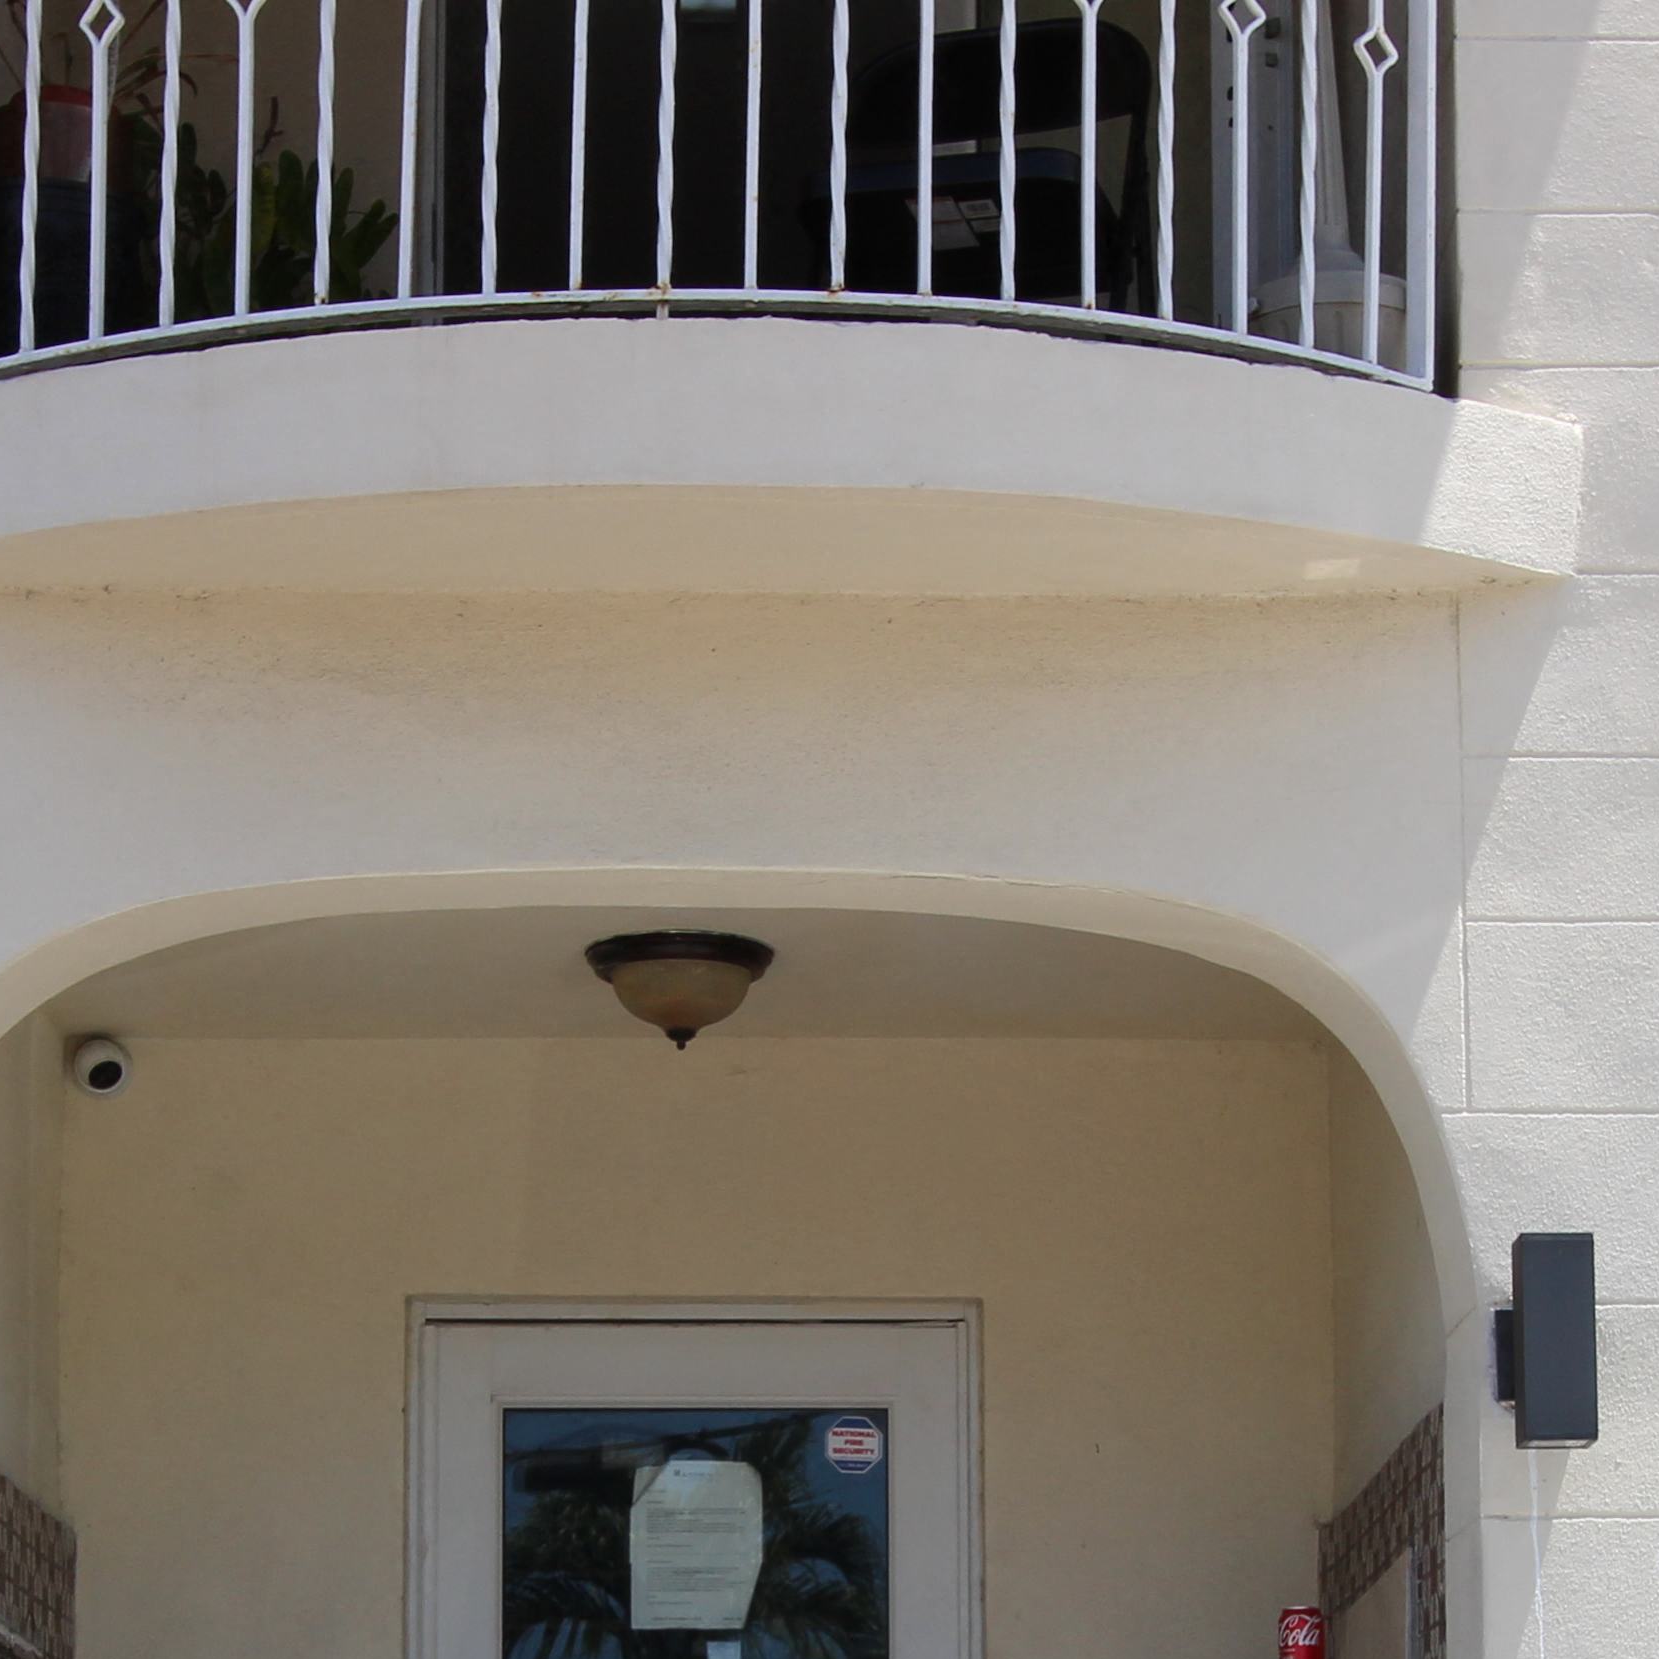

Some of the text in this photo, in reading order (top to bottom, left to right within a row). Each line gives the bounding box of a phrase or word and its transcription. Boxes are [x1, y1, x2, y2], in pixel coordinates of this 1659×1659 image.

[831, 1430, 877, 1438] NATIONAL
[844, 1439, 864, 1447] FIRE
[831, 1447, 876, 1456] SECURITY
[1279, 1614, 1321, 1648] Cola
